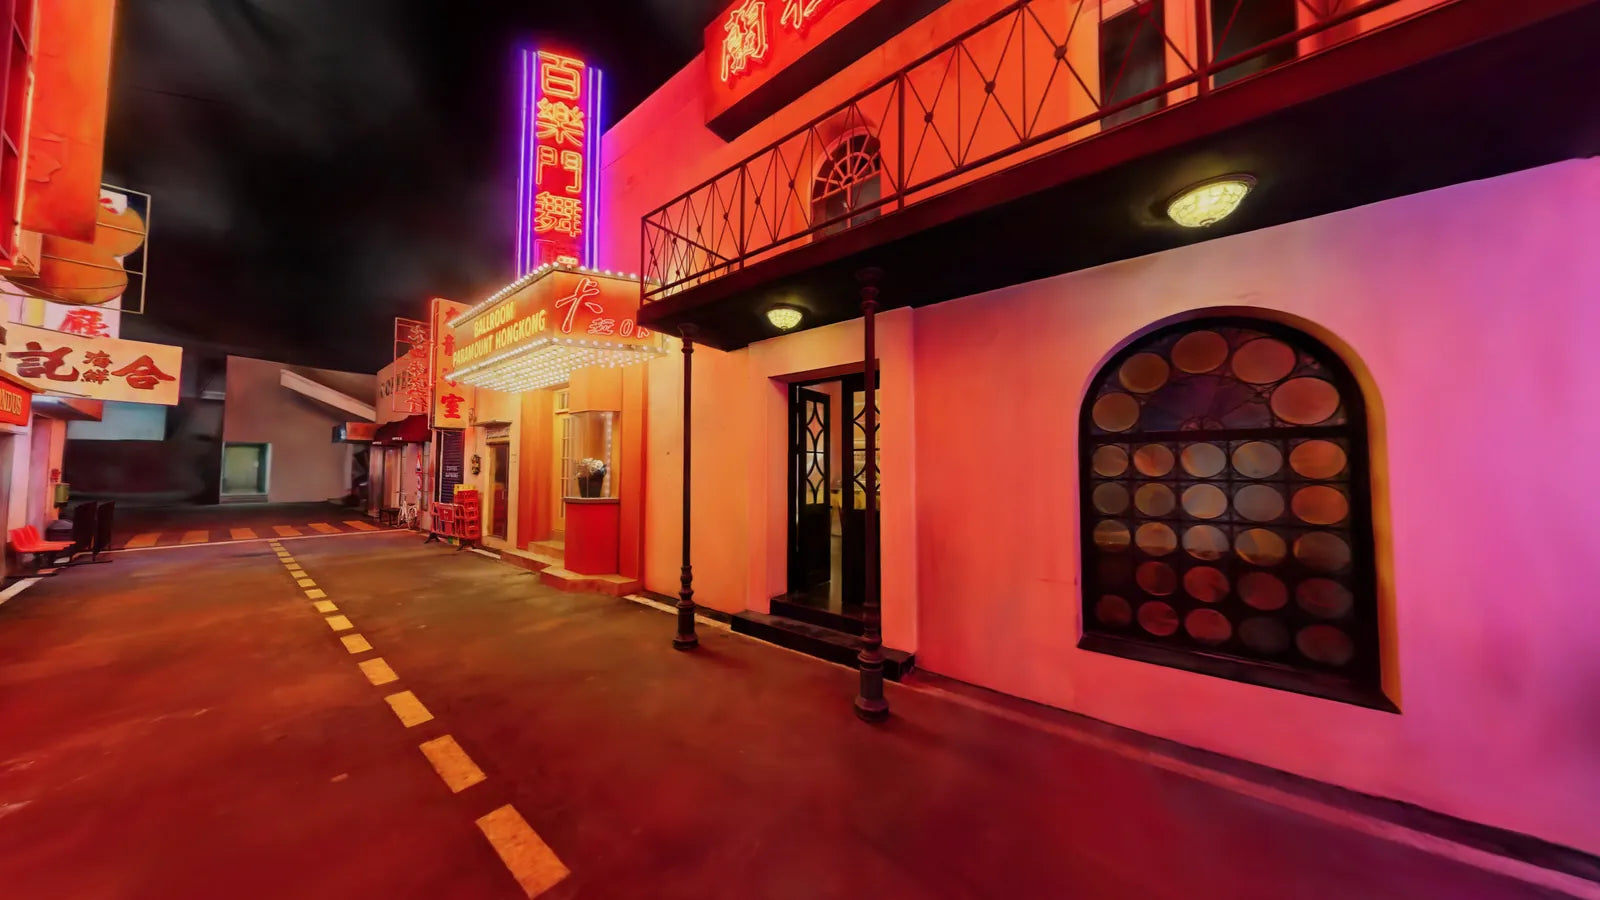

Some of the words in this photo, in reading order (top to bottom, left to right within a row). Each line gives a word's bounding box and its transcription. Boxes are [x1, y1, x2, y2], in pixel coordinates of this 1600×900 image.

[452, 334, 494, 368] PARAMOUNT
[495, 309, 546, 350] HONGKONG
[473, 301, 516, 338] BALLROOM
